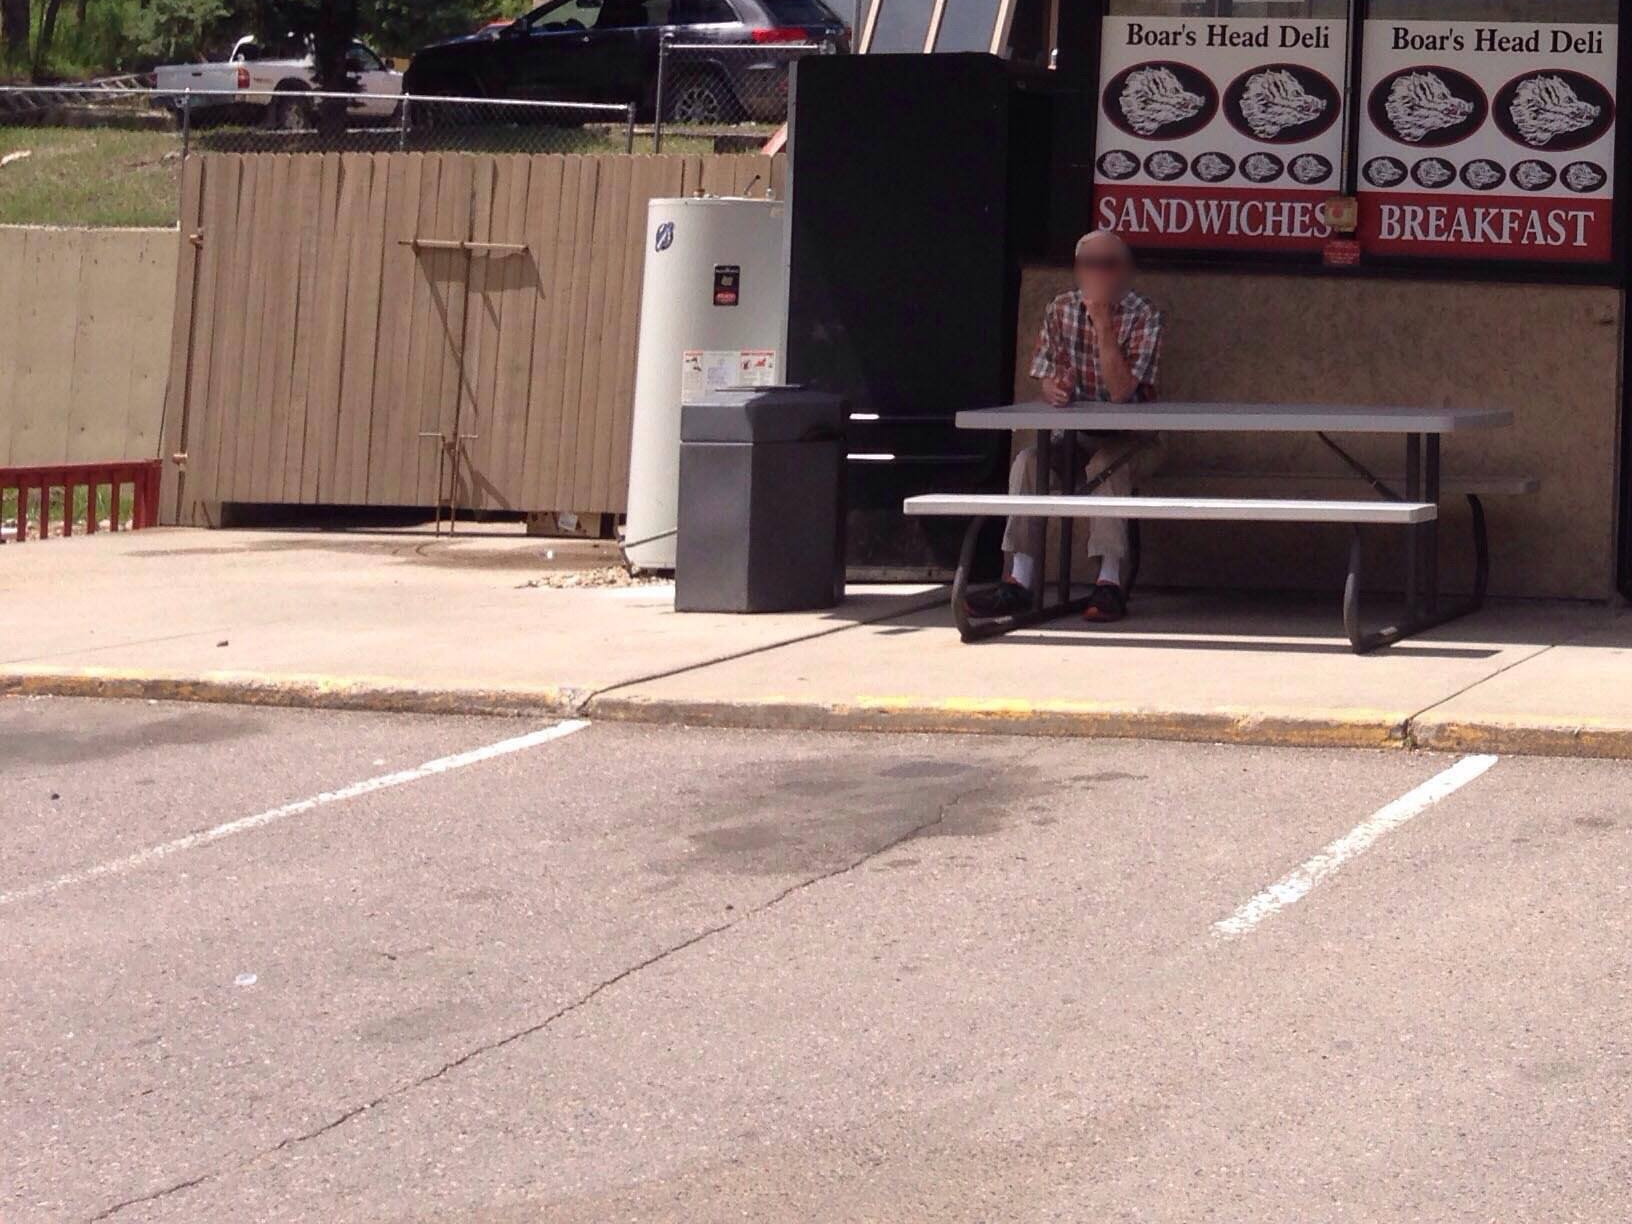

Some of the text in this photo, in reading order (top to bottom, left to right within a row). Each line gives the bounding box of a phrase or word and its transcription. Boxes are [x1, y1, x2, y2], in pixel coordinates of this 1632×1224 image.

[1126, 22, 1331, 50] Boar's Head Deli
[1391, 26, 1604, 56] Boar's Head Deli
[1098, 196, 1333, 240] SANDWICHES
[1379, 204, 1596, 248] BREAKFAST
